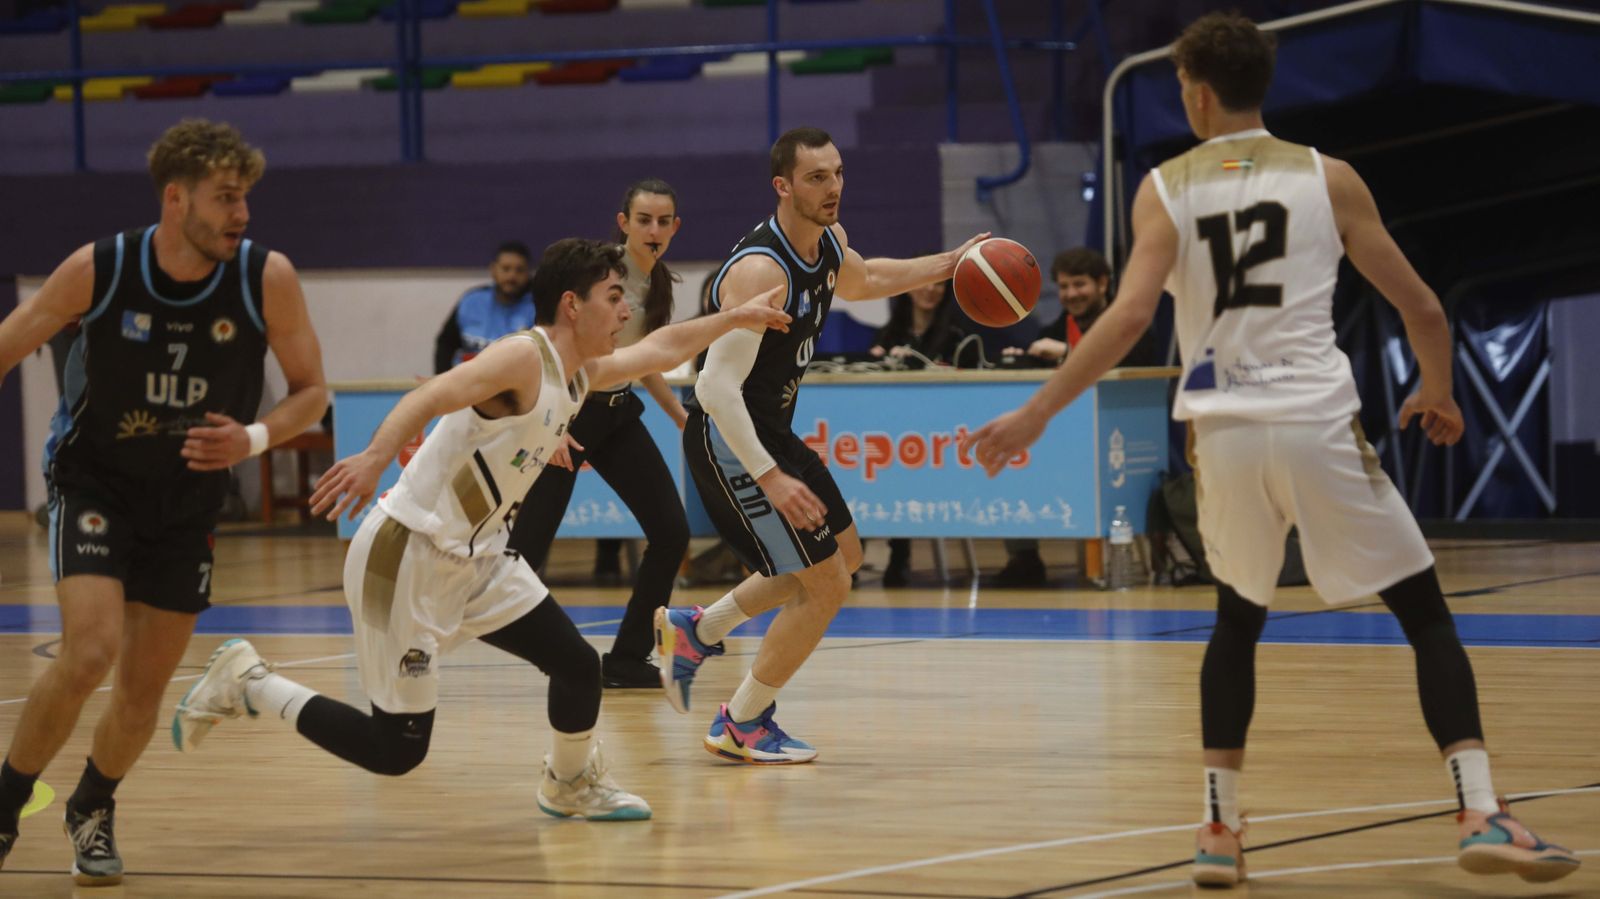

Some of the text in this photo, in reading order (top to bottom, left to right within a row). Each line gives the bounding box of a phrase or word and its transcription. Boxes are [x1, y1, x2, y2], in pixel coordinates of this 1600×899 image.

[1196, 201, 1289, 318] 12
[168, 343, 188, 371] 7
[730, 473, 773, 519] ULB
